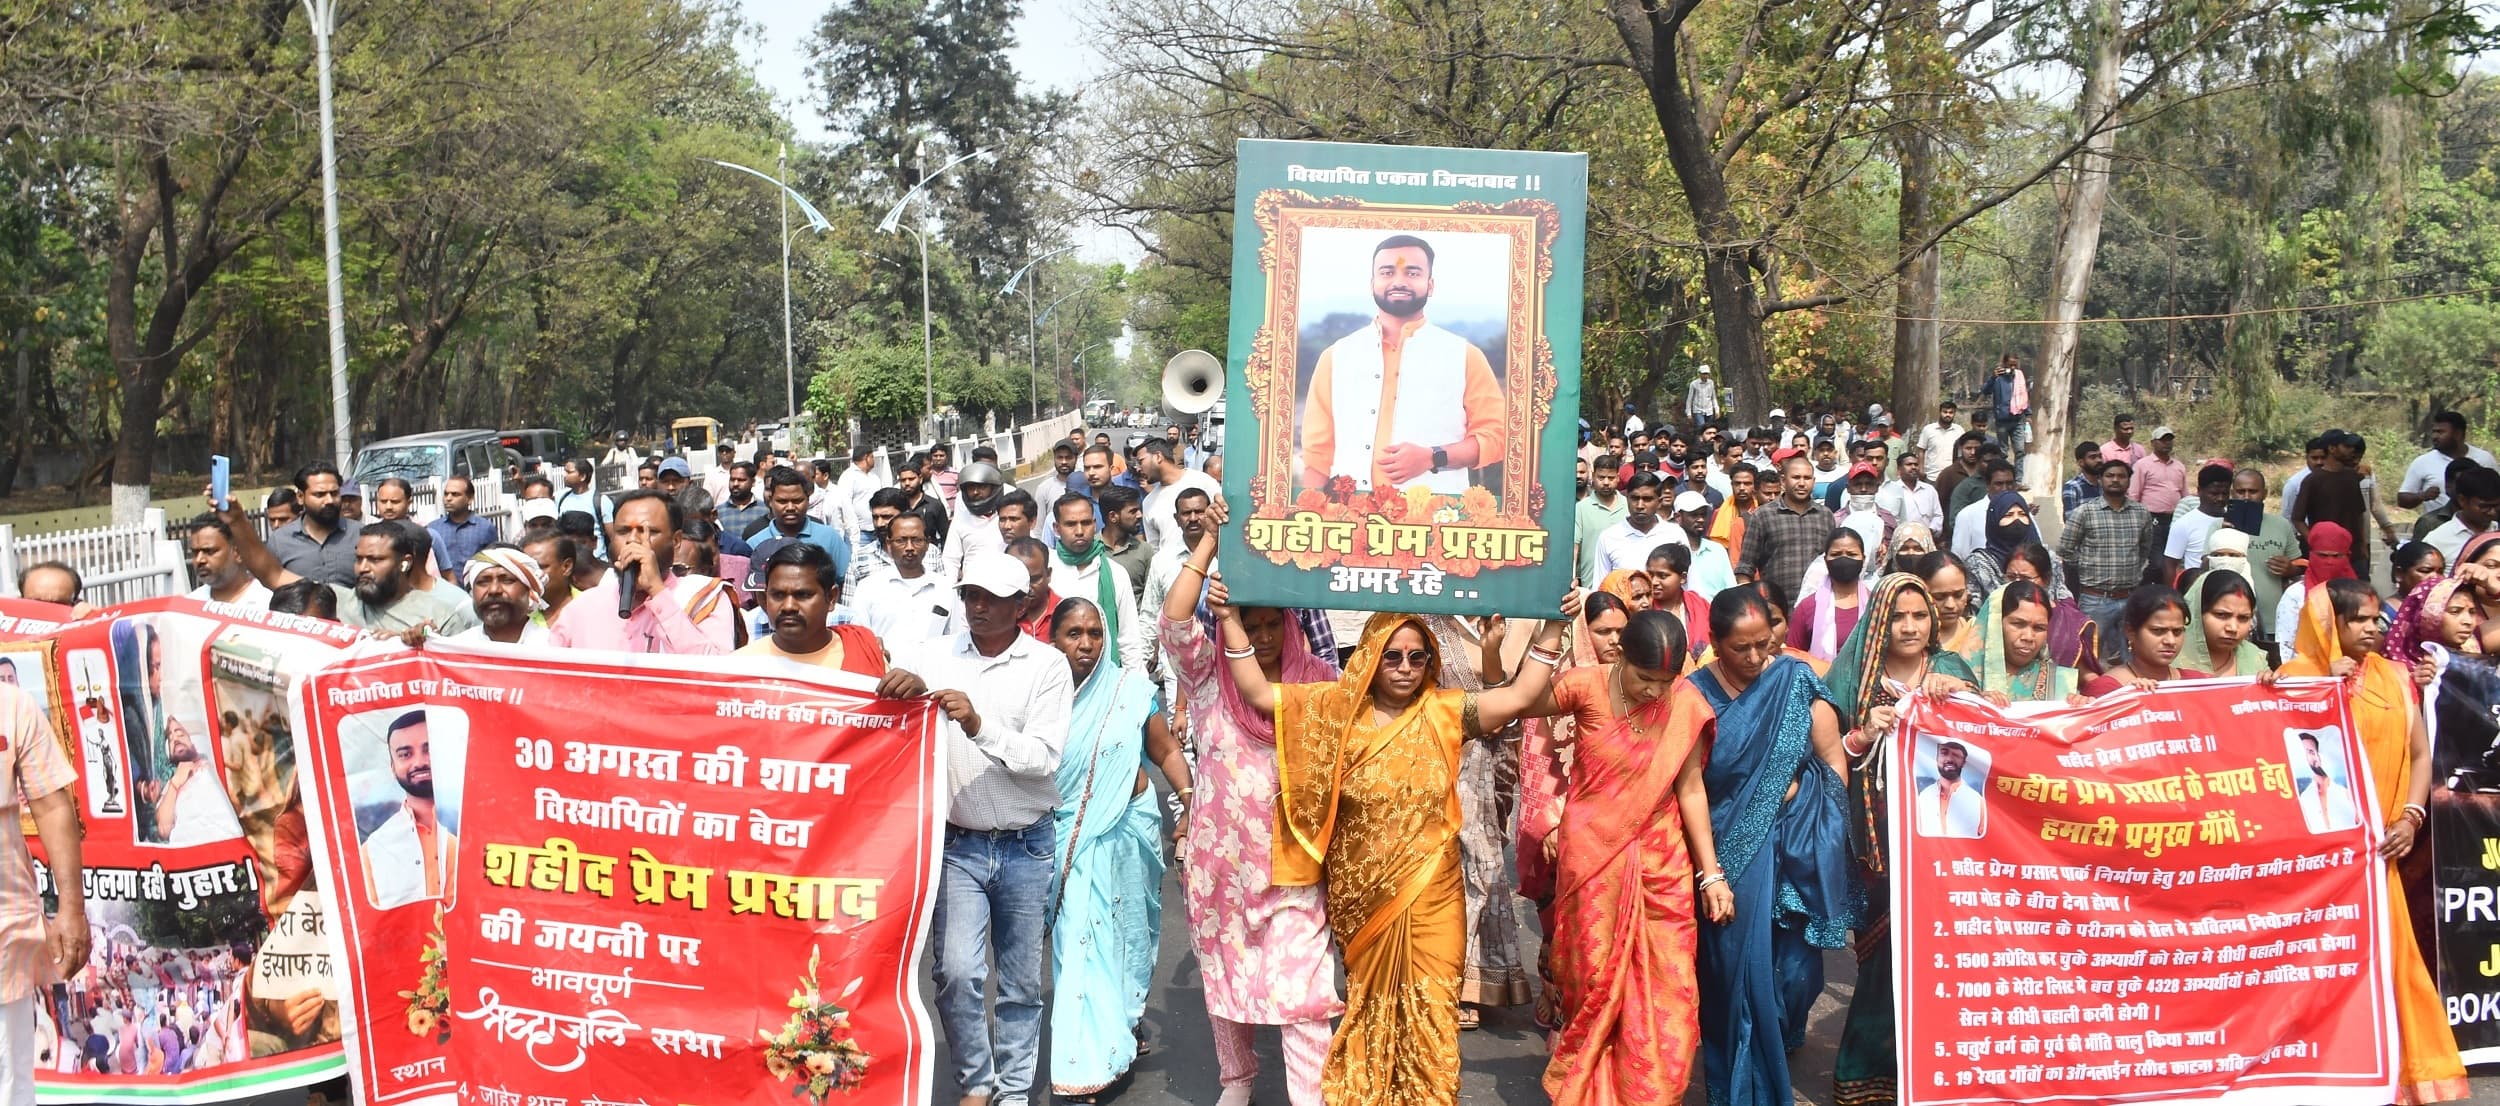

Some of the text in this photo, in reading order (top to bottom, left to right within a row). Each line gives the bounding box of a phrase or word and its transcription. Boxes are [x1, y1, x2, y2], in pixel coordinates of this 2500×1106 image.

[1287, 164, 1518, 190] विस्थापित एकता जिन्दाबाद
[1249, 511, 1548, 563] शहीद प्रेम प्रसाद
[1329, 565, 1401, 595] अमर
[1408, 562, 1447, 597] रहे
[327, 681, 404, 706] विस्थापित
[820, 707, 895, 729] जिन्दाबाद
[514, 736, 851, 795] 30 अगस्त की शाम
[2094, 747, 2123, 767] प्रेम
[2123, 739, 2167, 762] प्रसाद
[1997, 757, 2294, 806] शहीद प्रेम प्रसाद के न्याय हेतु
[534, 787, 814, 849] विस्थापितों का बेटा
[2040, 815, 2120, 847] हमारी
[2125, 820, 2196, 858] प्रमुख
[96, 868, 138, 899] लगा
[141, 863, 167, 900] रही
[168, 862, 239, 911] गुहार
[484, 836, 885, 922] शहीद प्रेम प्रसाद
[1951, 857, 1985, 877] शहीद
[1989, 858, 2017, 878] प्रेम
[2020, 864, 2058, 881] प्रसाद
[2059, 863, 2092, 882] पार्क
[2093, 866, 2150, 885] निर्माण
[2152, 867, 2175, 890] हेतु
[2177, 870, 2195, 886] 20
[2256, 857, 2293, 877] जमीन
[1948, 891, 1978, 907] नया
[2004, 888, 2022, 907] के
[2026, 890, 2060, 910] बीच
[2062, 891, 2089, 911] देना
[2091, 891, 2121, 911] होगा
[479, 906, 702, 967] की जयन्ती पर
[1953, 916, 1992, 936] शहीद
[1994, 916, 2012, 936] प्रेम
[2012, 919, 2052, 936] प्रसाद
[2055, 918, 2073, 937] के
[2126, 919, 2148, 937] को
[2302, 907, 2325, 925] देना
[262, 943, 313, 984] इंसाफ
[1955, 952, 1990, 969] 1500
[2037, 951, 2057, 966] कर
[2059, 950, 2088, 971] चुके
[2149, 950, 2171, 967] को
[2172, 948, 2198, 966] सेल
[2248, 940, 2285, 960] बहाली
[2286, 937, 2317, 955] करना
[530, 966, 633, 1006] भावपूर्ण
[1956, 982, 1992, 998] 7000
[1995, 979, 2011, 996] के
[2115, 975, 2144, 998] चुके
[2145, 978, 2180, 994] 4328
[2244, 968, 2262, 986] को
[2338, 961, 2360, 976] कर
[1958, 1007, 1988, 1027] सेल
[2042, 1004, 2081, 1025] बहाली
[2082, 1002, 2115, 1022] करनी
[2117, 1001, 2149, 1022] होगी
[650, 1027, 726, 1060] सभा
[1956, 1035, 1991, 1061] चतुर्थ
[1994, 1034, 2018, 1055] वर्ग
[2020, 1035, 2041, 1054] को
[2044, 1033, 2065, 1058] पूर्व
[2067, 1033, 2083, 1053] की
[2144, 1029, 2183, 1049] किया
[2184, 1029, 2217, 1046] जाय
[390, 1056, 447, 1083] स्थान
[1956, 1071, 1973, 1086] 19
[2045, 1066, 2064, 1081] का
[2283, 1040, 2307, 1058] करो
